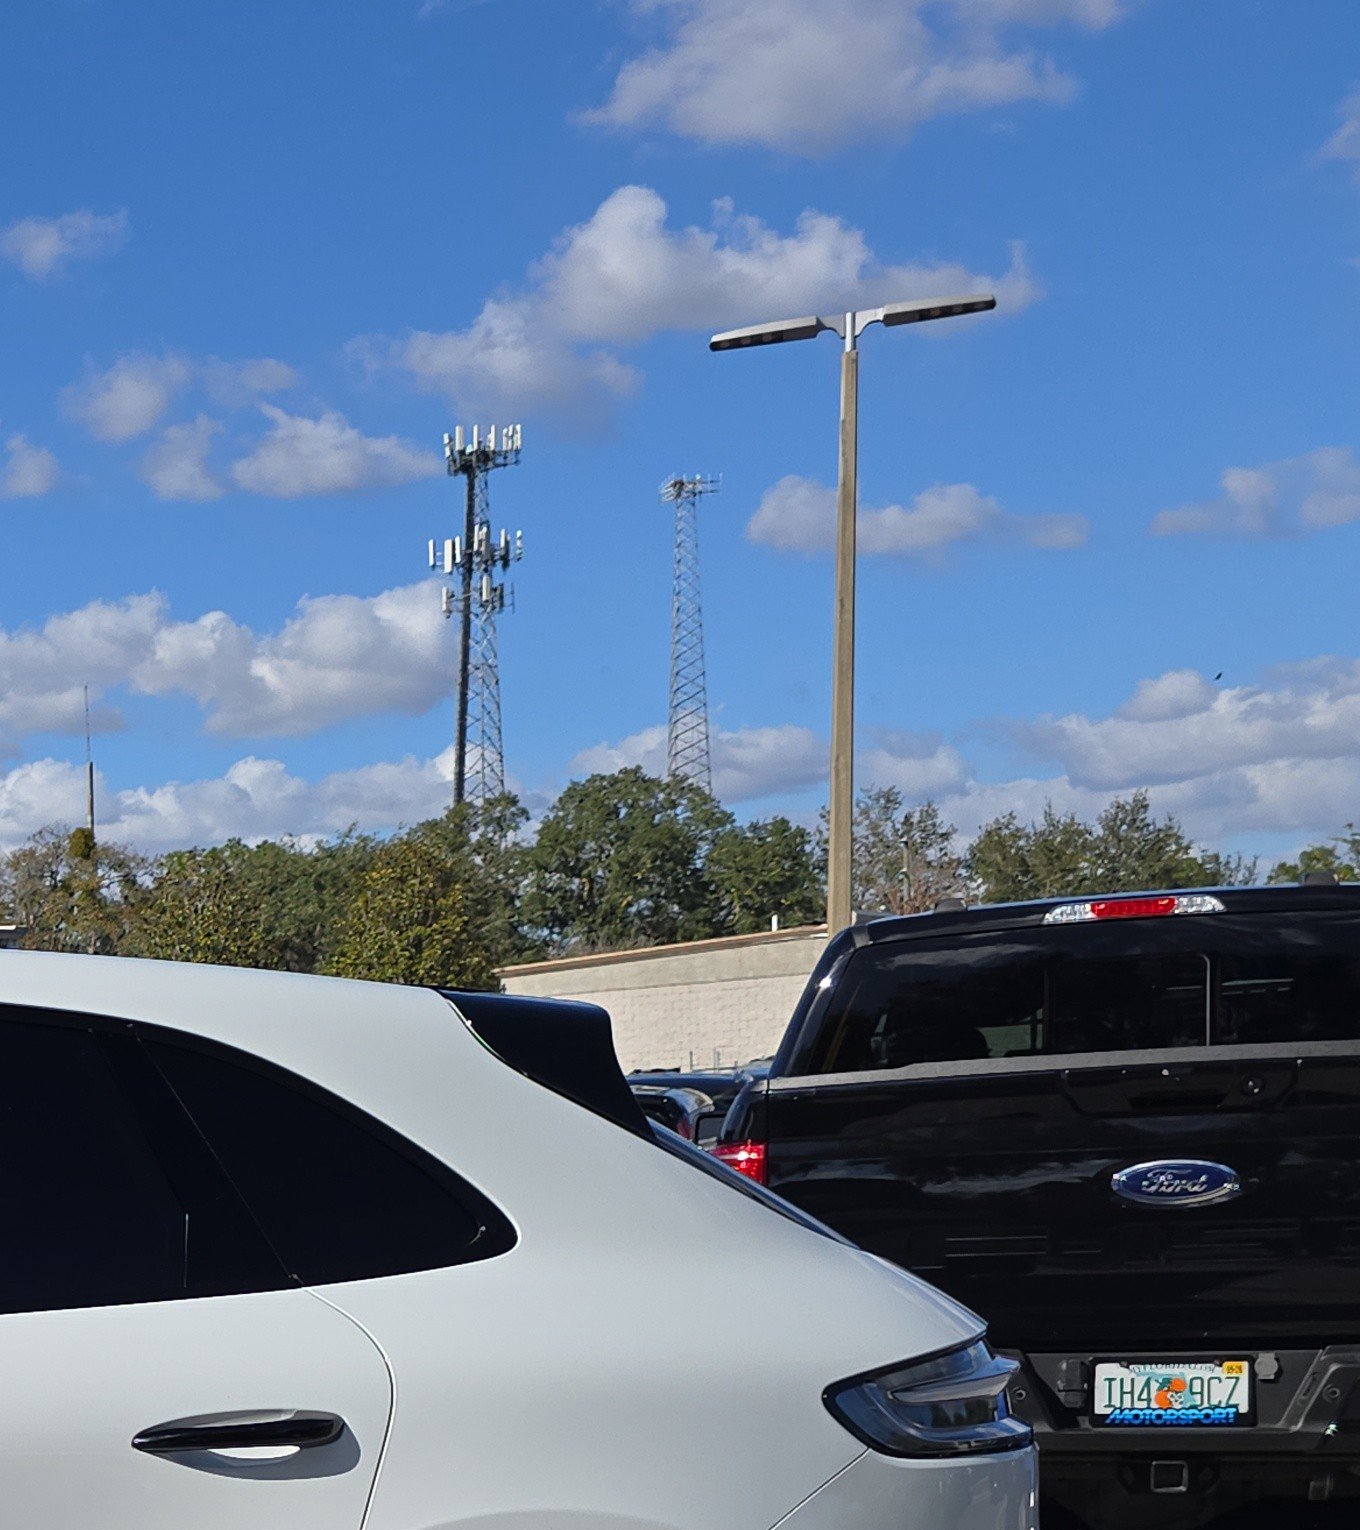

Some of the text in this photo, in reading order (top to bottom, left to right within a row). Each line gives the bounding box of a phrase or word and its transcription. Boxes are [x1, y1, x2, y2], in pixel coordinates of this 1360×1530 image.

[1141, 1168, 1209, 1193] Ford
[1103, 1376, 1241, 1408] IH4 9CZ
[1104, 1406, 1239, 1425] MOTORSPORT
